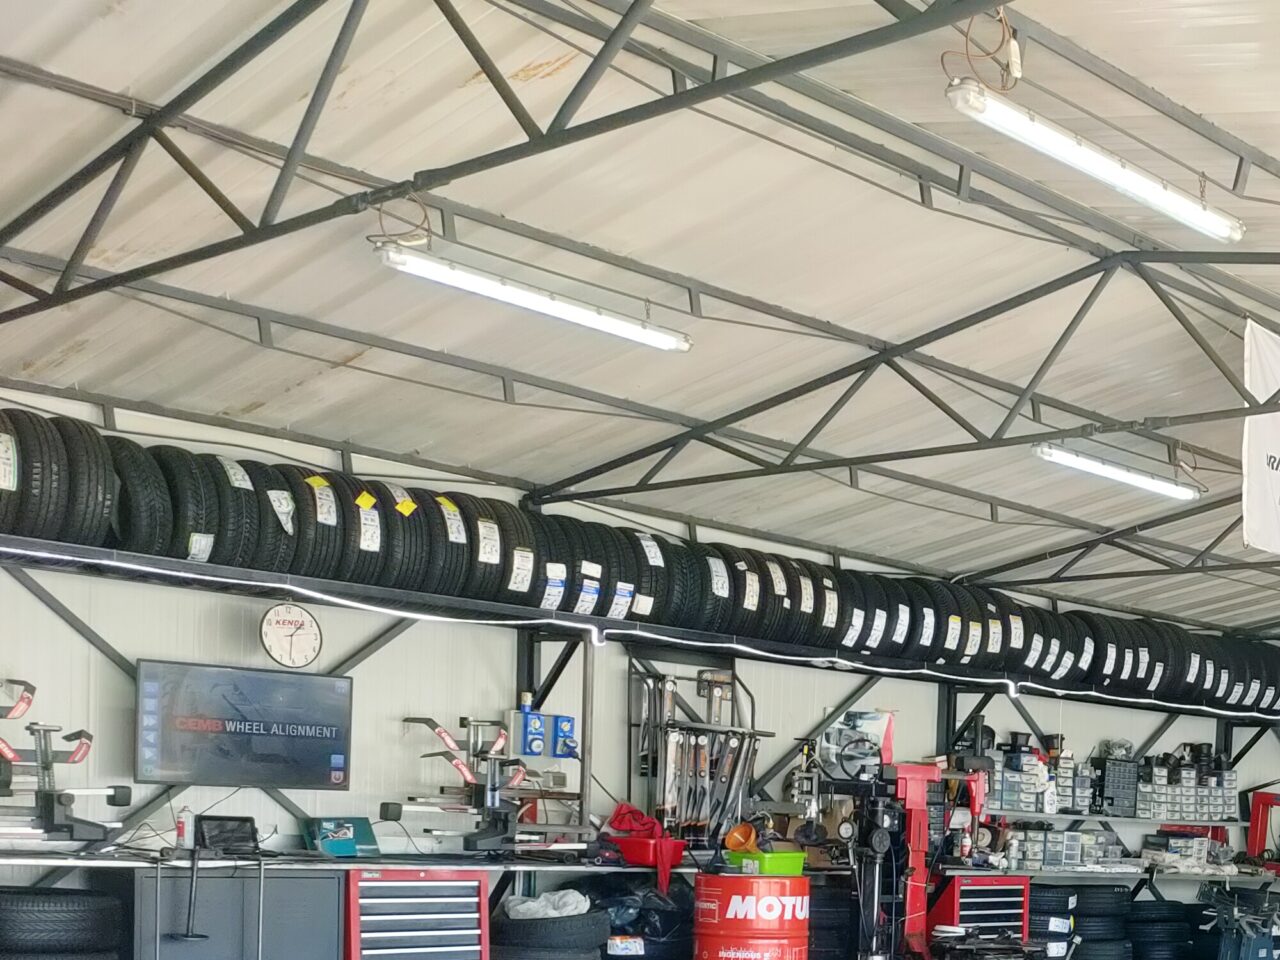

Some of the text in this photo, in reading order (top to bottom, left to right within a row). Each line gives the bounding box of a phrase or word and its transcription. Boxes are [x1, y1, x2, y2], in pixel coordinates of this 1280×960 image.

[275, 619, 305, 627] KENDA
[175, 716, 338, 739] CEMB WHEEL ALIGNMENT
